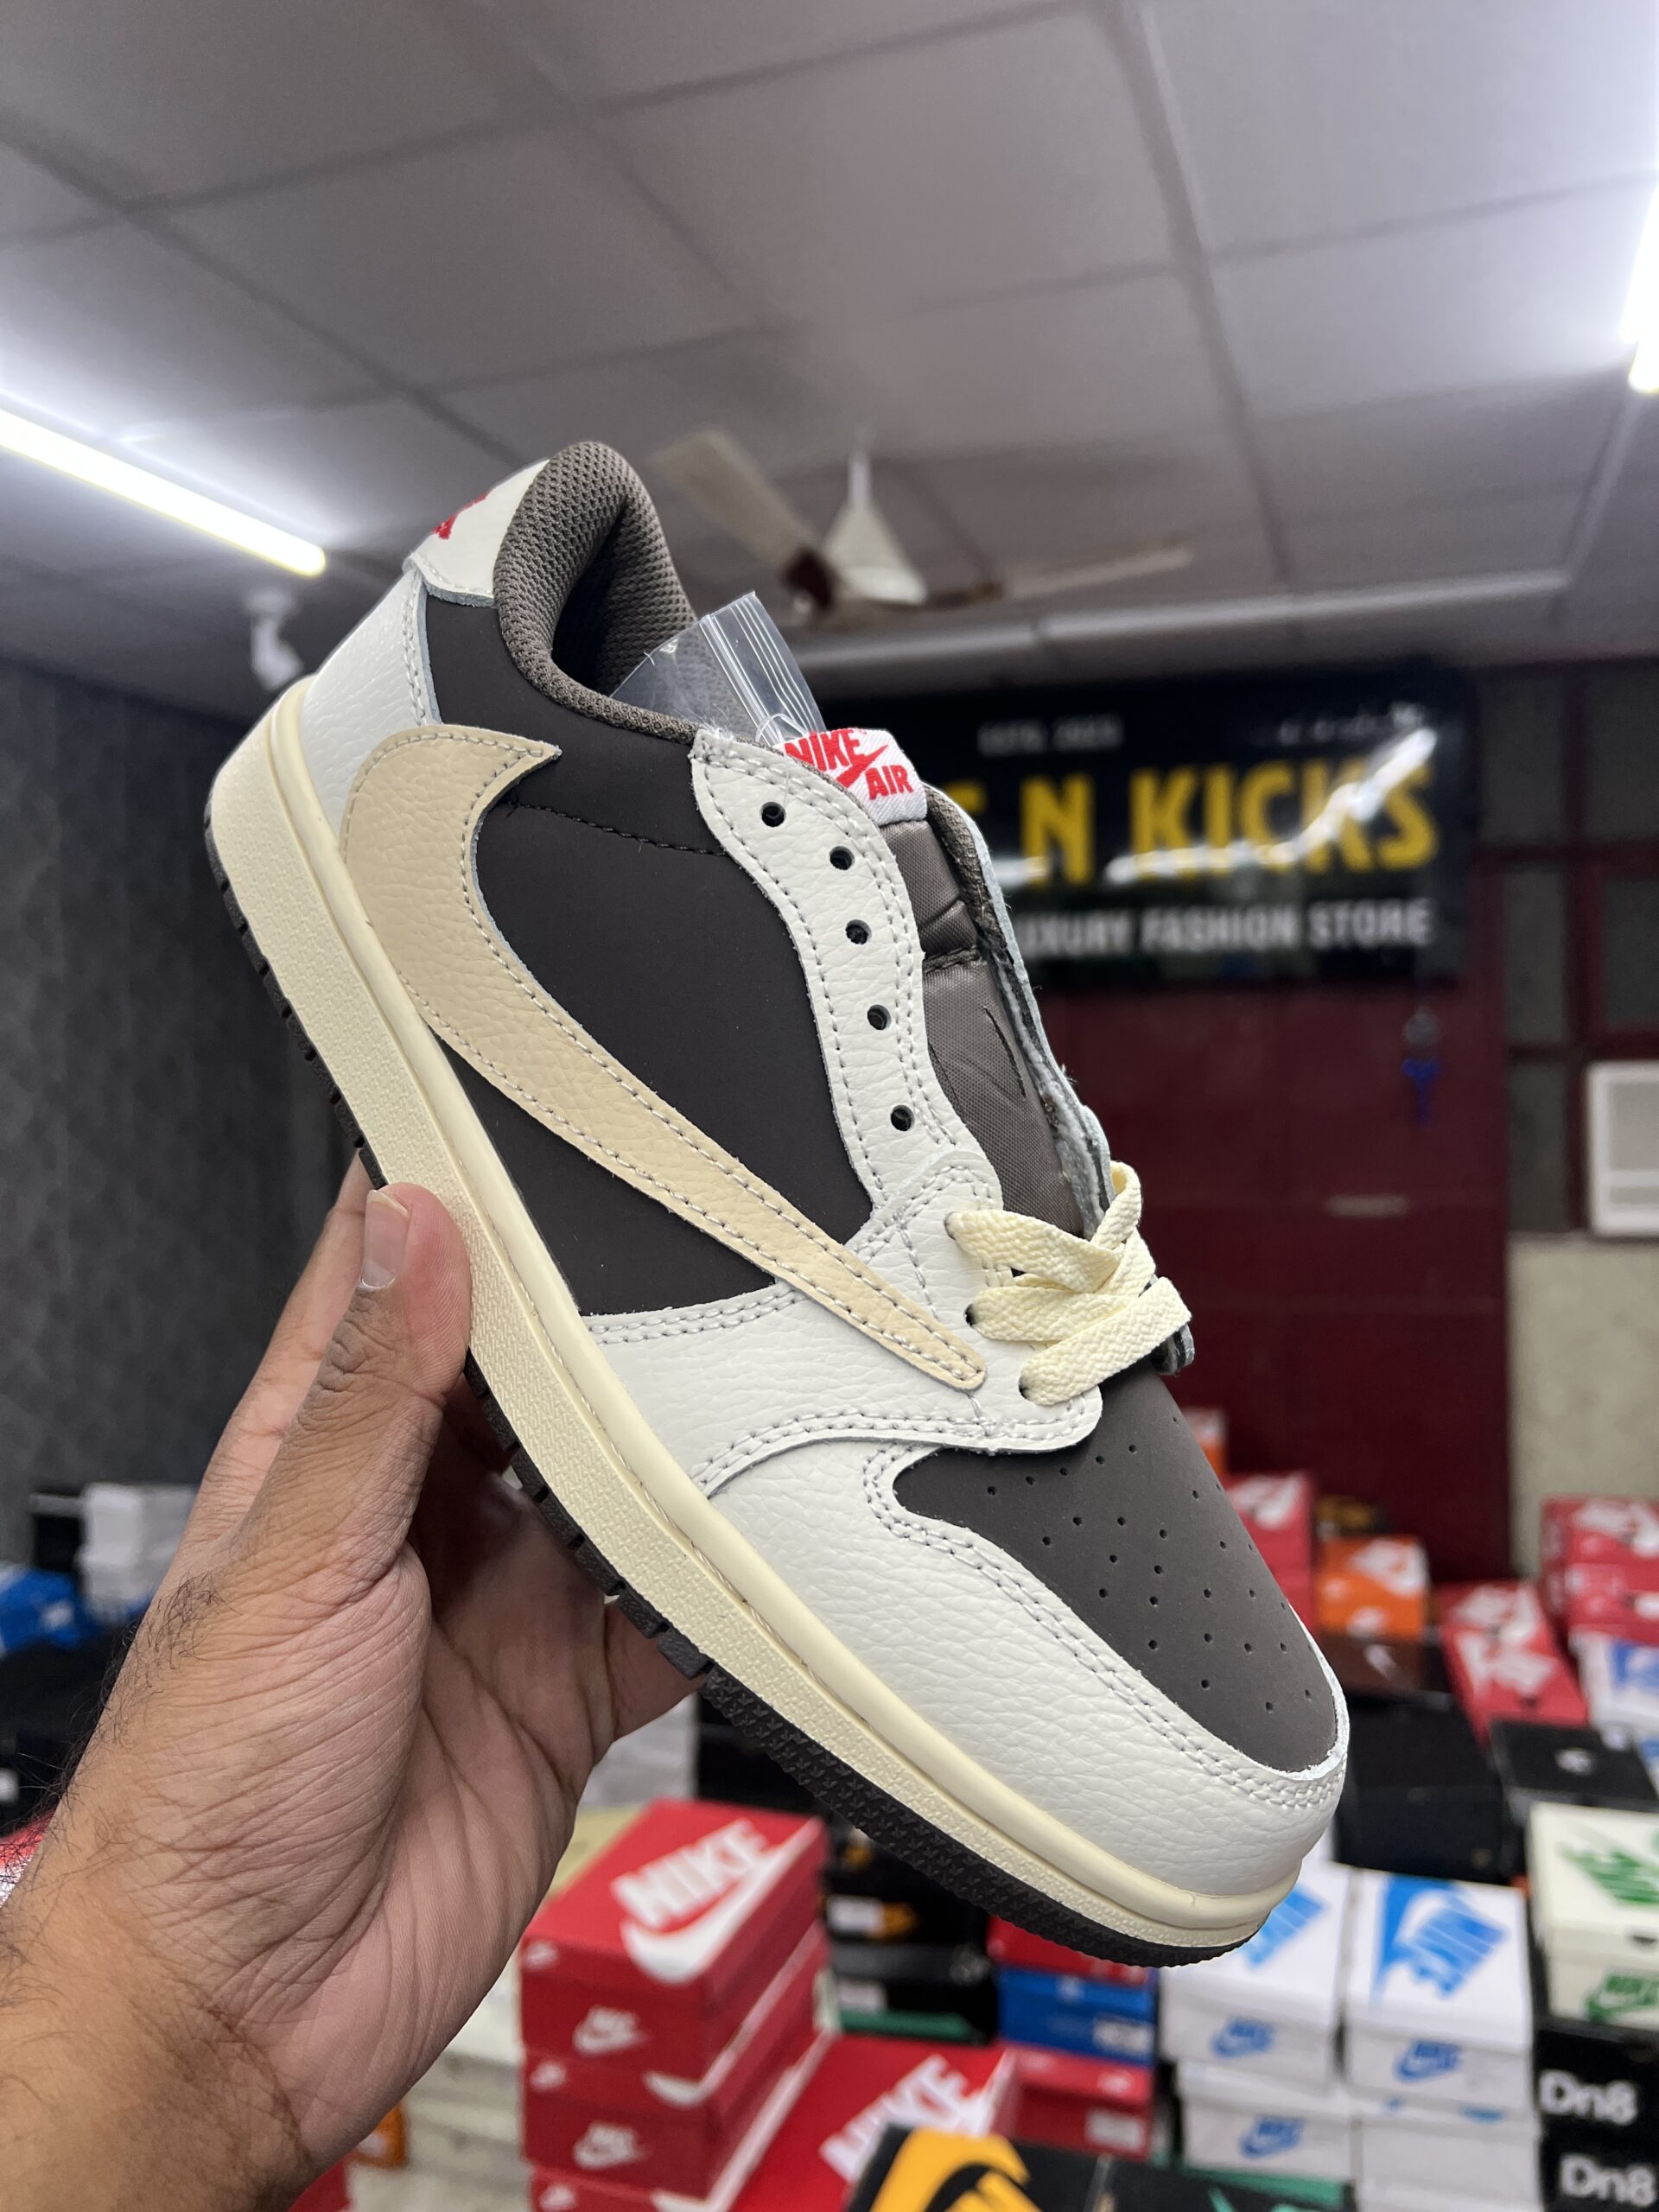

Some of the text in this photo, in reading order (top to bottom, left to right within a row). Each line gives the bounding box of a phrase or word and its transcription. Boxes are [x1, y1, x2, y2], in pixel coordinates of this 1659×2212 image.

[784, 728, 860, 772] NIKE
[865, 765, 913, 800] AIR
[1020, 758, 1438, 884] N KICKS
[1014, 898, 1432, 957] UXURY FASHION STORE
[610, 1818, 769, 1927] NIKE
[1540, 2069, 1637, 2126] Dn8
[1561, 2153, 1656, 2208] Dn8
